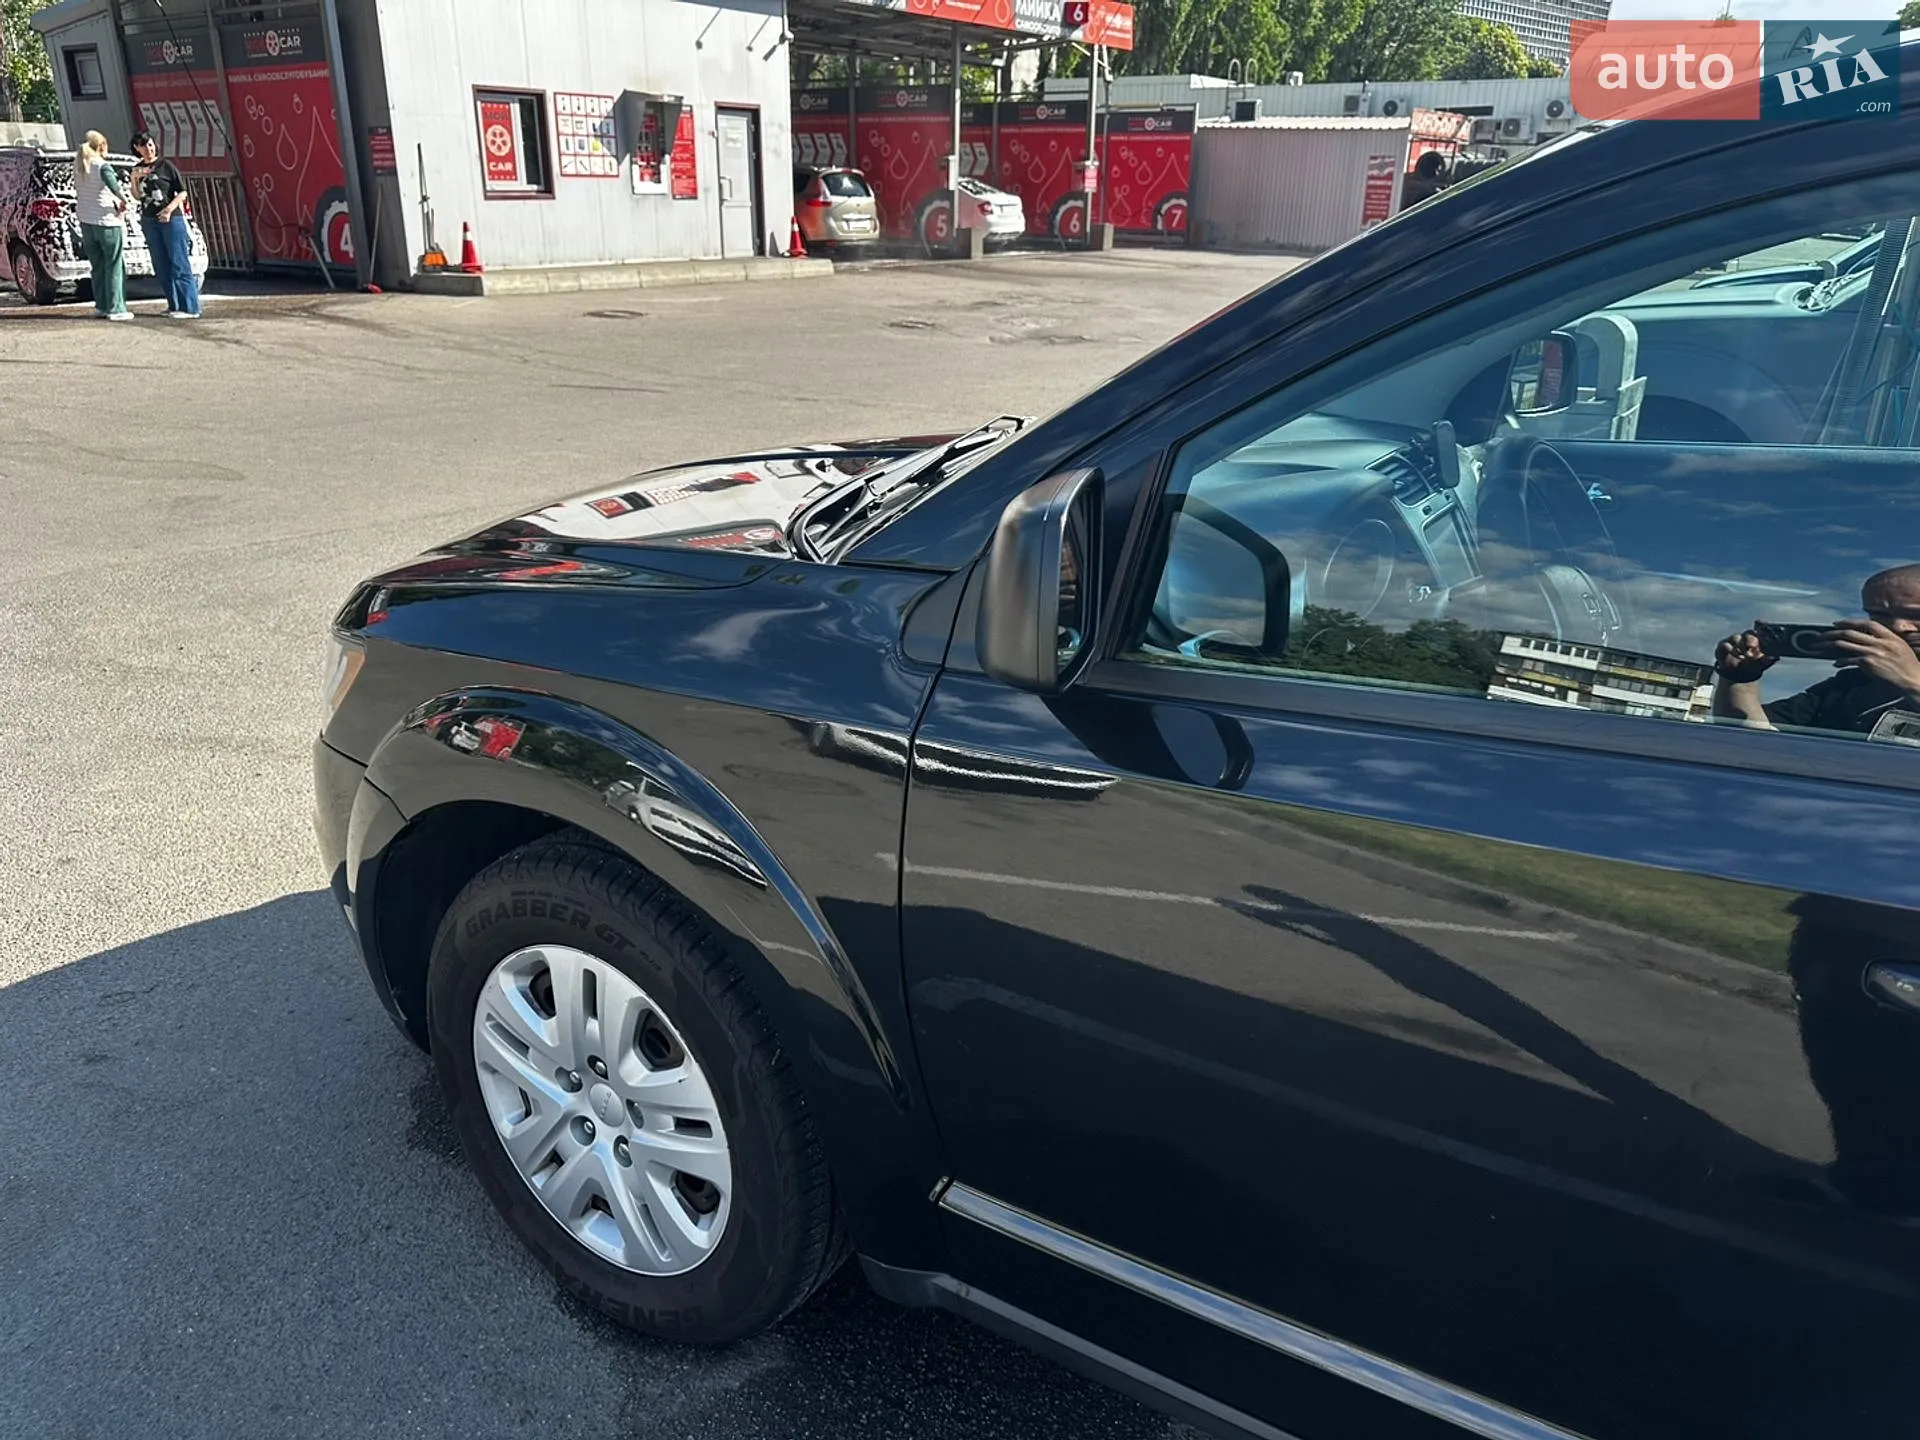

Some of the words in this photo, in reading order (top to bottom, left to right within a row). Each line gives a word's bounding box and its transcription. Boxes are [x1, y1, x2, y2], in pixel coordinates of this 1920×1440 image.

[1073, 4, 1083, 21] 6
[279, 36, 301, 48] CAR
[489, 162, 513, 171] CAR
[936, 214, 948, 238] 5
[1069, 212, 1081, 233] 6
[1171, 210, 1182, 228] 7
[340, 223, 354, 258] 4
[464, 899, 592, 940] GRABBER
[595, 924, 637, 951] GT
